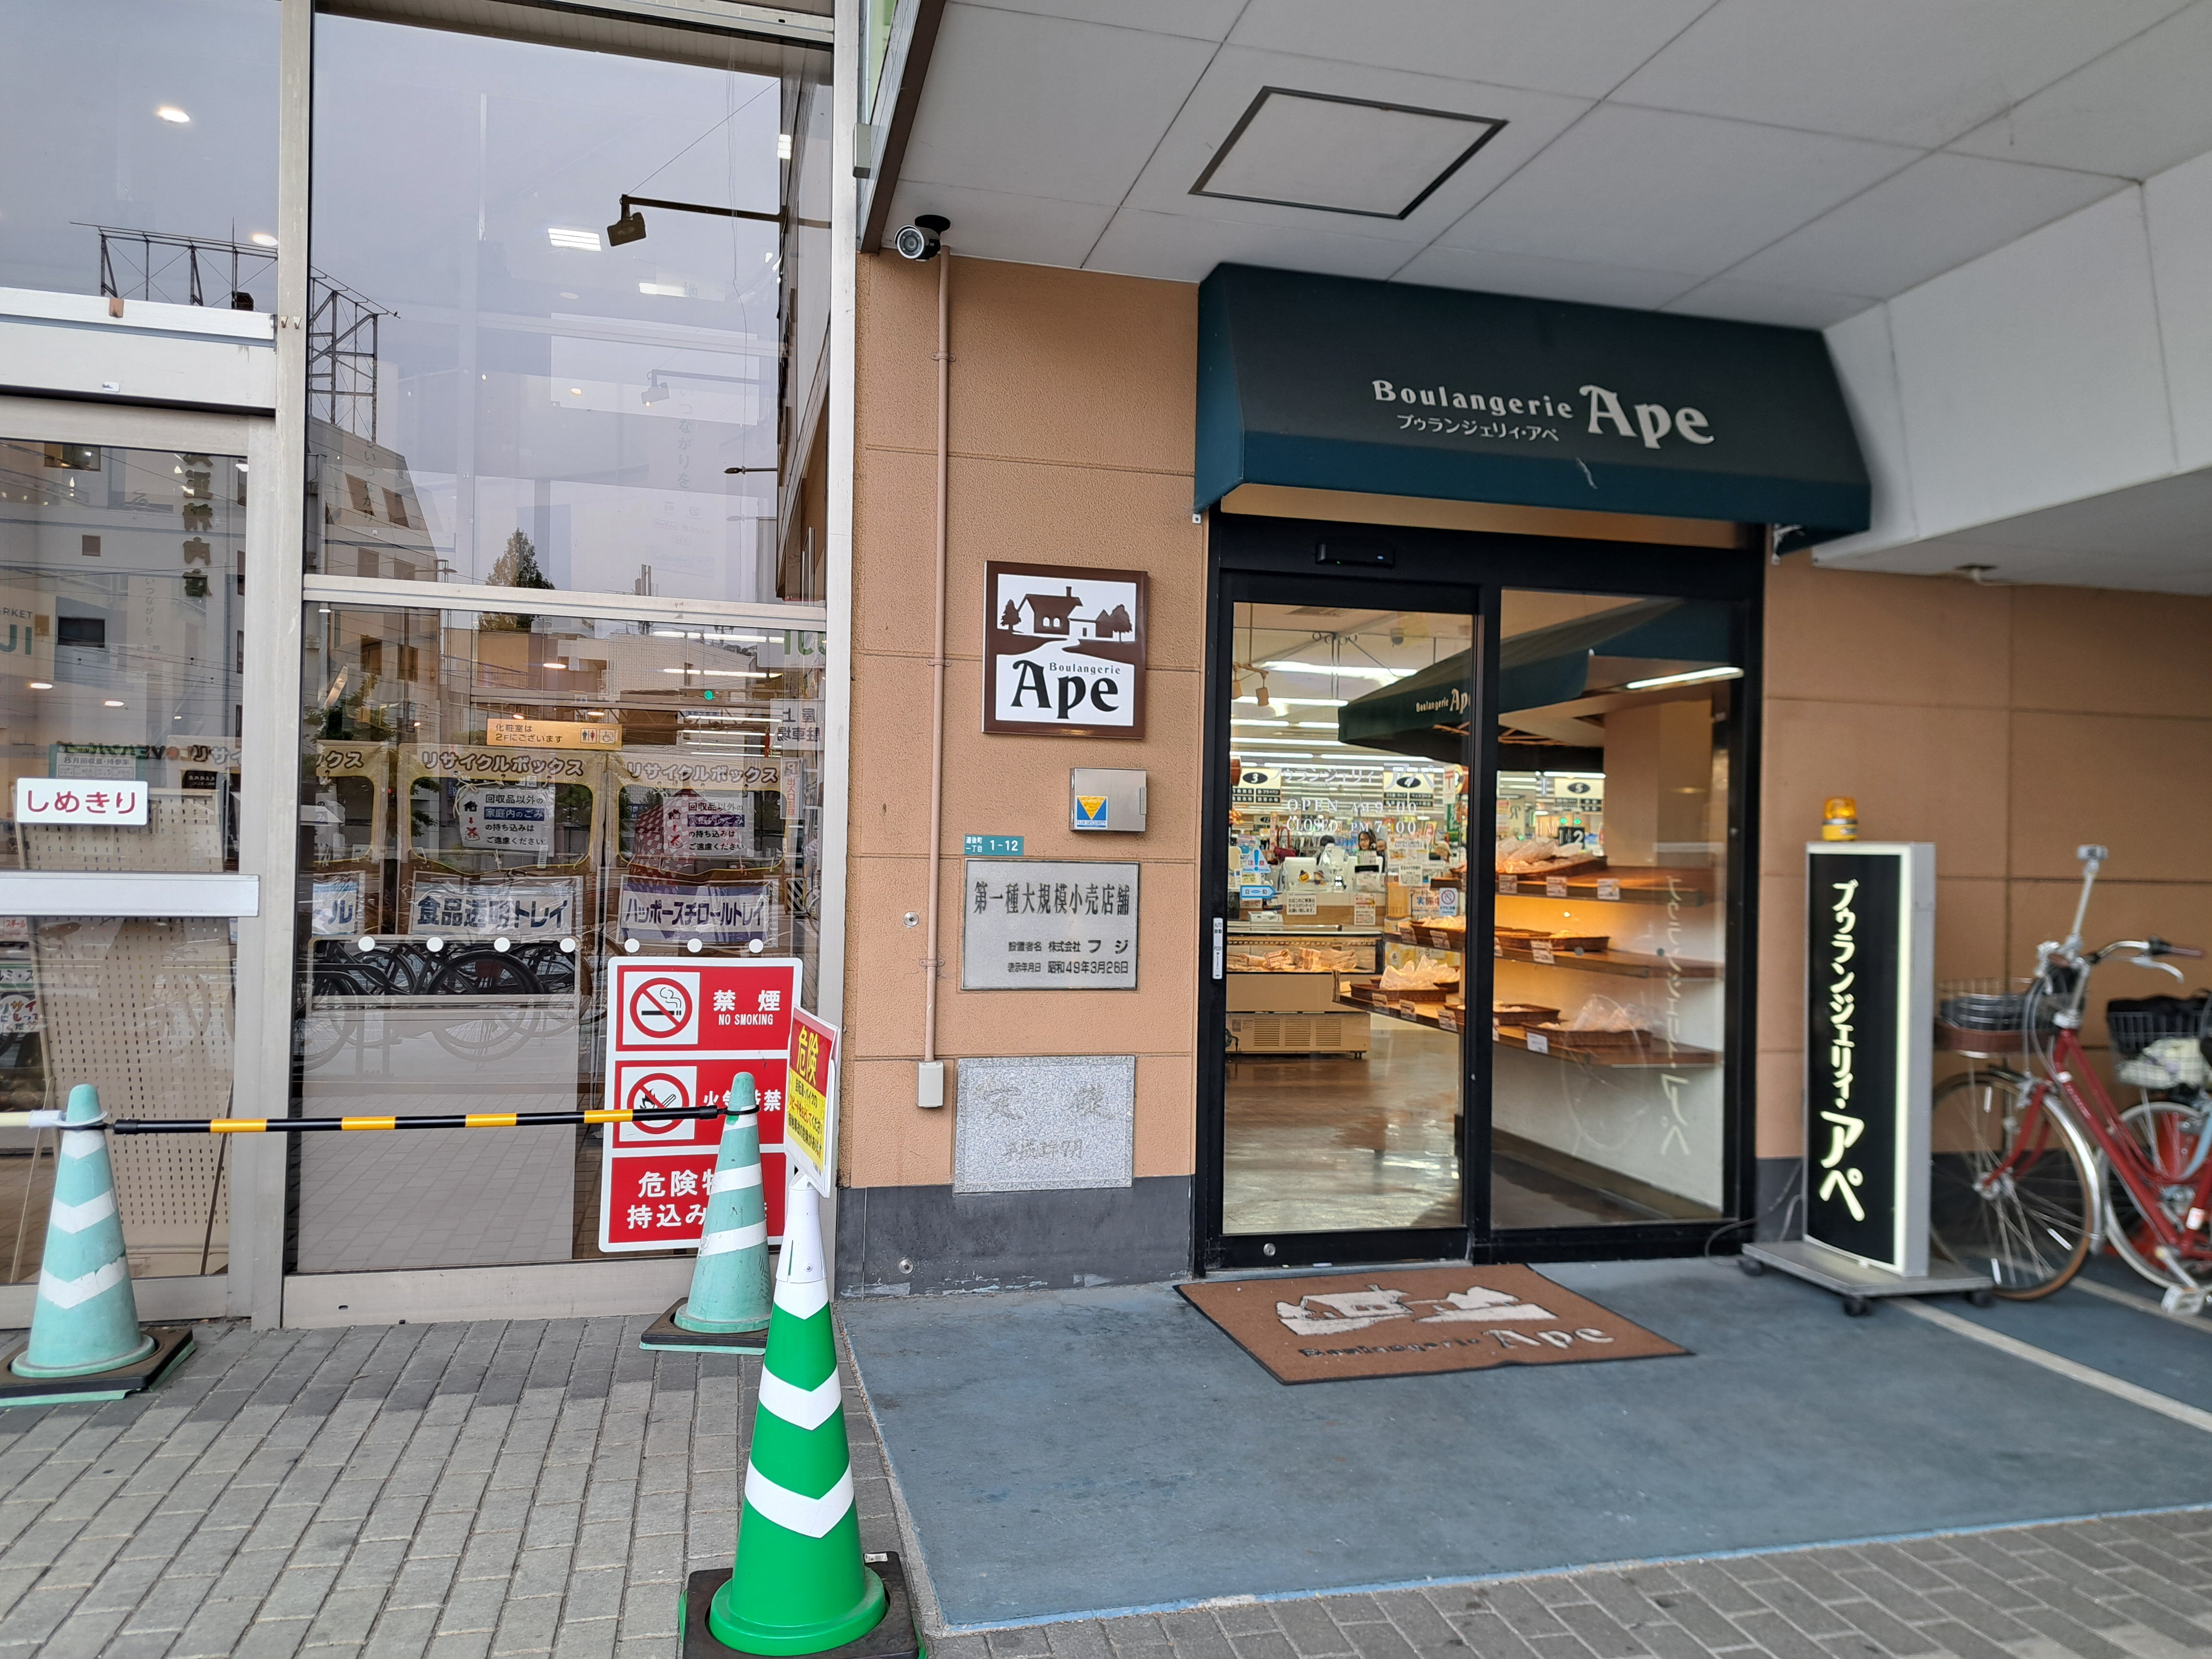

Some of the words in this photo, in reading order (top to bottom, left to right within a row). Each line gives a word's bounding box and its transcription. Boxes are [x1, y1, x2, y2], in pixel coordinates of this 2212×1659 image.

[1372, 379, 1574, 419] Boulangerie
[1579, 384, 1715, 449] Ape
[0, 606, 33, 619] RKET
[1049, 662, 1121, 675] Boulangerie
[1010, 660, 1120, 719] Ape
[1416, 697, 1449, 713] Boulangerie
[1450, 688, 1471, 715] Ap
[496, 723, 532, 732] 化粧室は
[496, 733, 563, 743] 2Fにございます
[421, 751, 584, 776] リサイクルボックス
[627, 761, 778, 783] リサイクルボックス
[1250, 773, 1259, 783] 3
[28, 790, 136, 814] しめきり
[486, 794, 543, 805] 回収品以外の
[688, 802, 743, 811] 回収品以外の
[1287, 799, 1338, 812] OPEN
[1351, 803, 1369, 813] AM
[1375, 801, 1417, 814] 9:00
[485, 808, 543, 819] 家庭内のごみ
[688, 816, 744, 825] 家庭内のごみ
[1286, 818, 1338, 832] CLOSED
[1351, 822, 1369, 831] PM
[1374, 820, 1416, 833] 7:00
[485, 824, 534, 832] の持ち込みは
[487, 837, 543, 845] ご遠慮ください
[990, 840, 1018, 852] 1-12
[973, 881, 1130, 916] 第一種大規模小売店舗
[625, 897, 764, 927] ハッポースチロールトレイ
[1008, 941, 1042, 952] 設置者名
[1048, 940, 1081, 953] 株式会社
[1007, 962, 1041, 973] 表示年月日
[719, 1014, 731, 1026] NO
[734, 1013, 774, 1026] SMOKING
[796, 1024, 819, 1087] 危険
[1820, 878, 1866, 1222] ブゥランジェリィ・アペ
[795, 1077, 818, 1109] 自転車・バイクの
[1483, 1327, 1615, 1349] Ape
